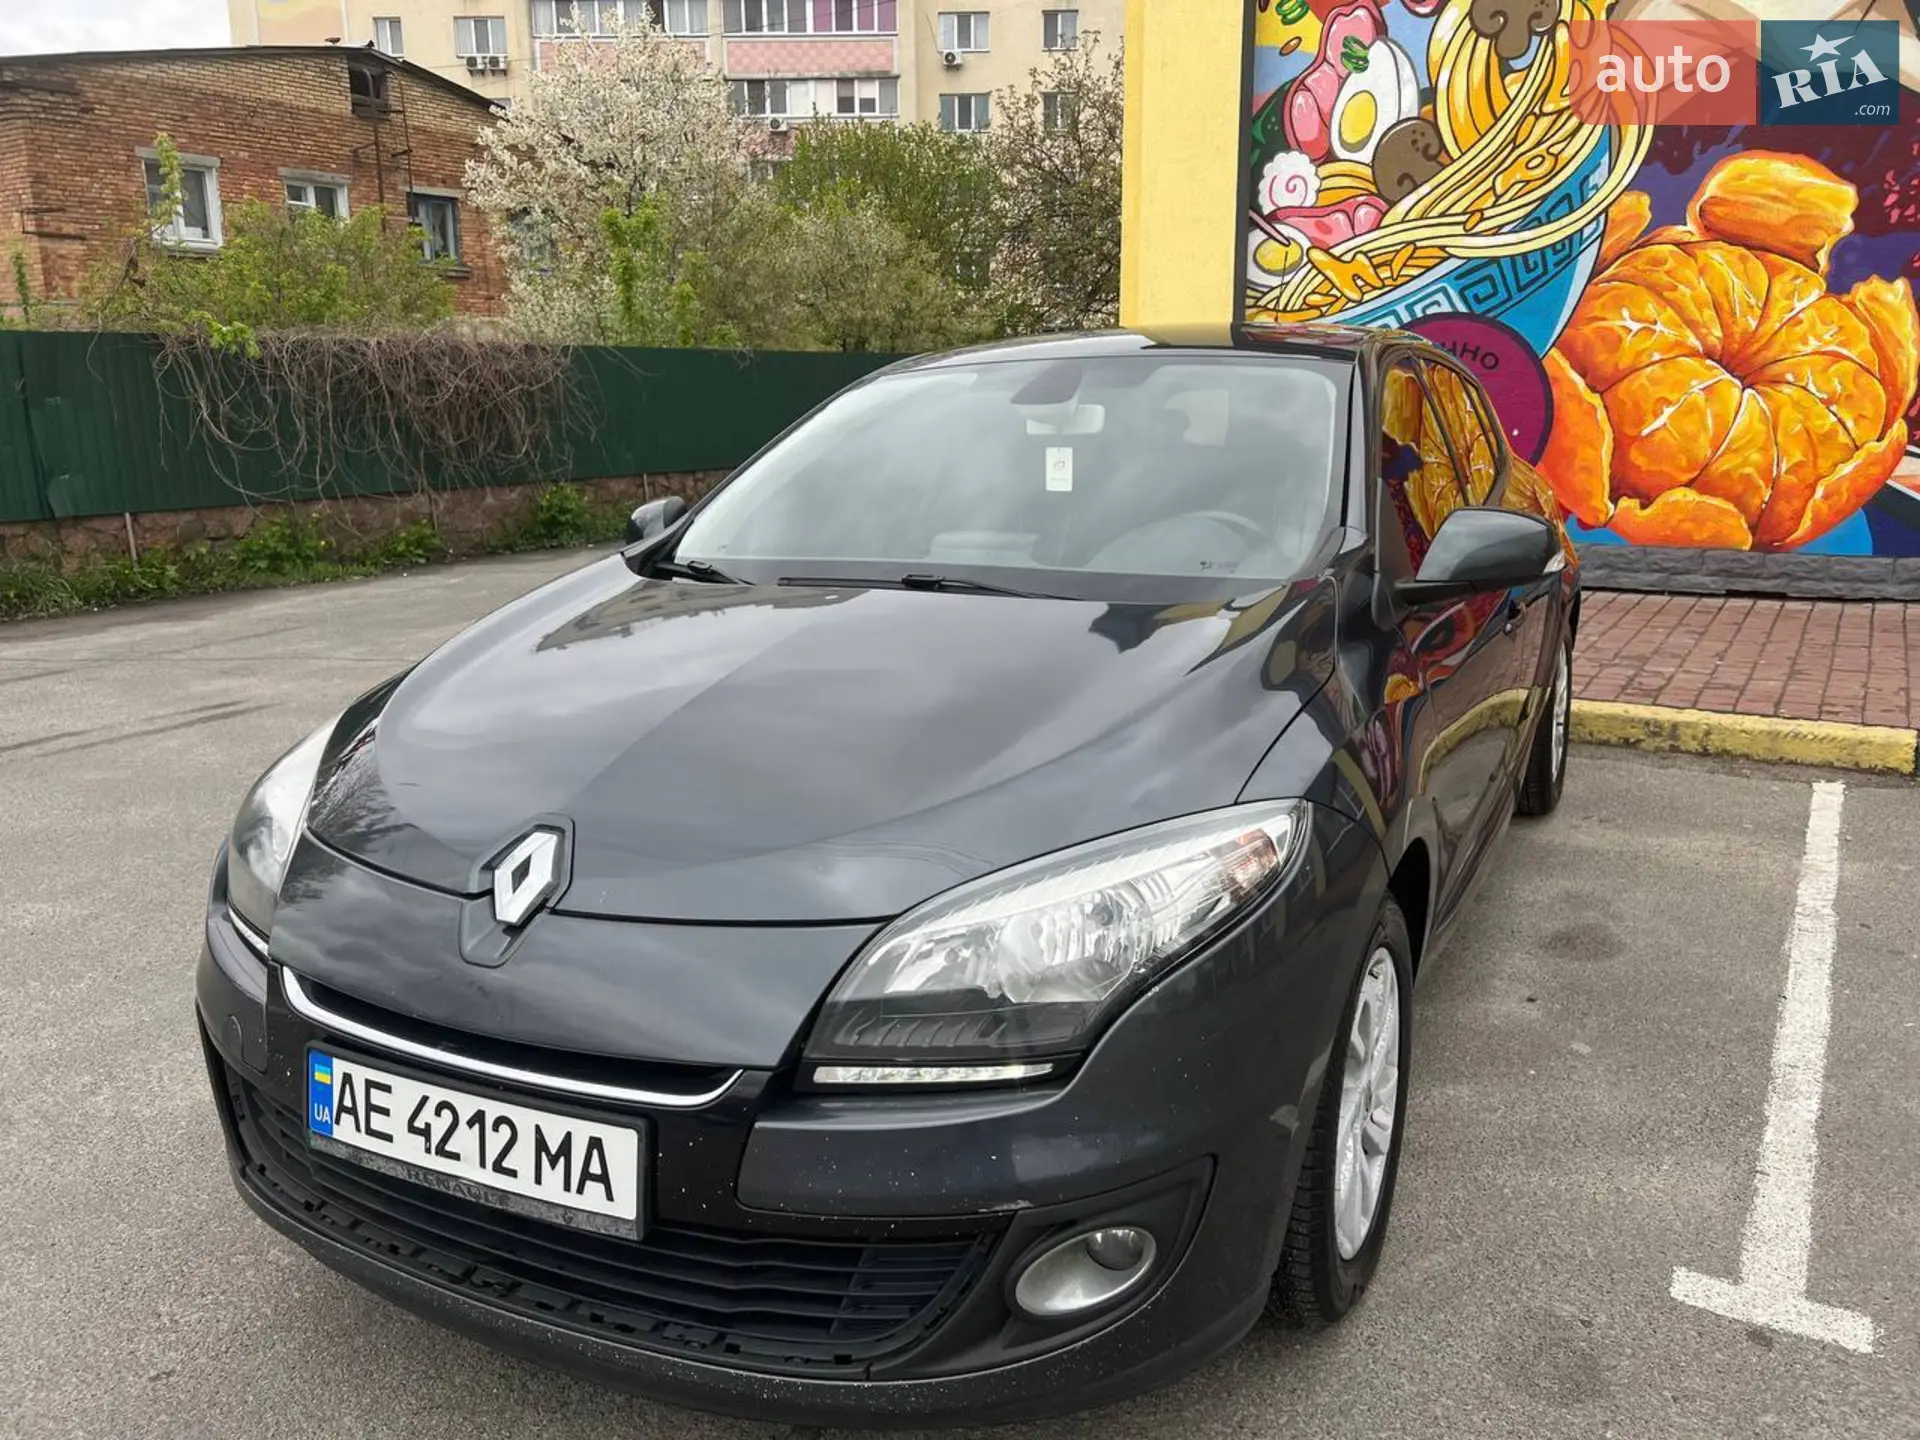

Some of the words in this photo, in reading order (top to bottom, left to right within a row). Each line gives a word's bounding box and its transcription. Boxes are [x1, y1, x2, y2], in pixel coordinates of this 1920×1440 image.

[314, 1102, 331, 1125] UA
[334, 1072, 394, 1143] AE
[407, 1095, 518, 1178] 4212
[534, 1123, 615, 1202] MA
